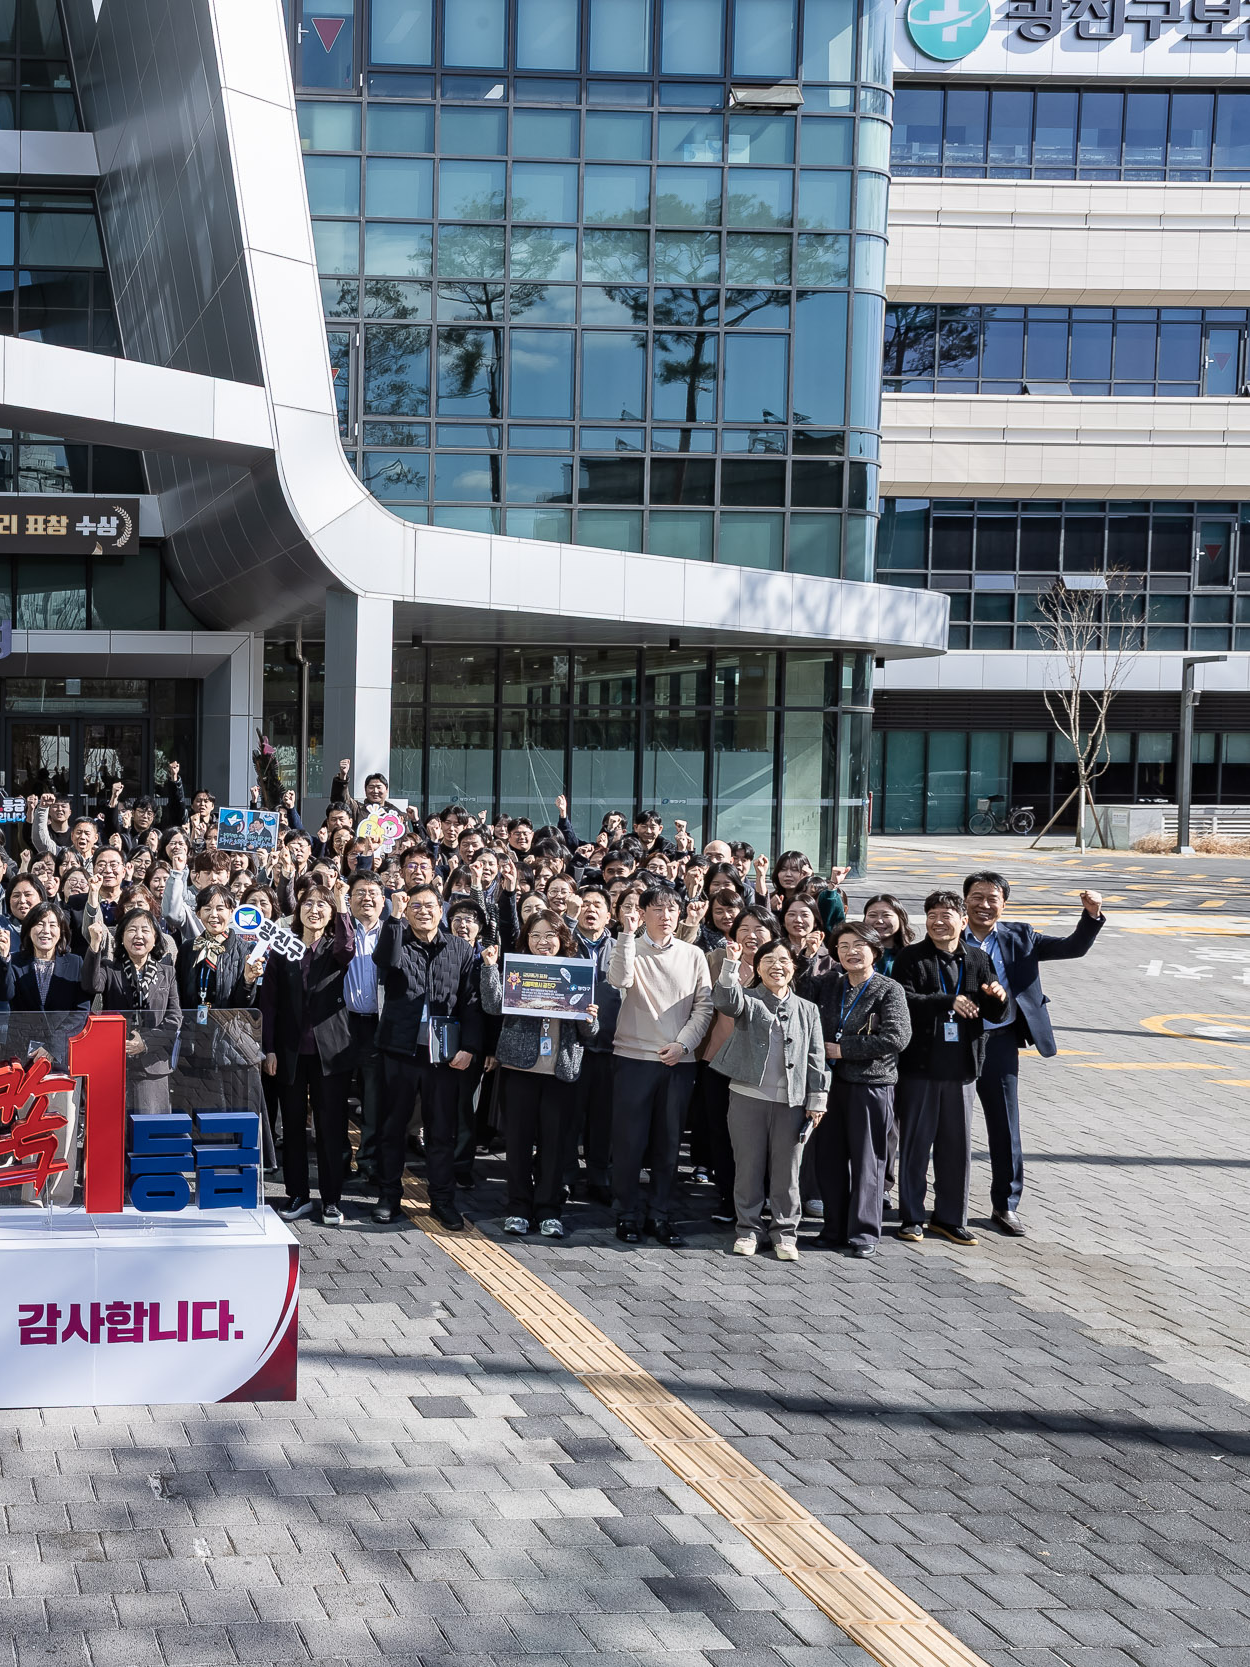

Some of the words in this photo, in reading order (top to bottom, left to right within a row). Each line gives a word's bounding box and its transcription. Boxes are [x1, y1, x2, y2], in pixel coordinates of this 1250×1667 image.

[1009, 0, 1250, 42] 광진구보
[25, 514, 69, 536] 표창
[75, 515, 118, 537] 수상
[258, 920, 304, 959] 광진구
[18, 1299, 244, 1346] 감사합니다.
